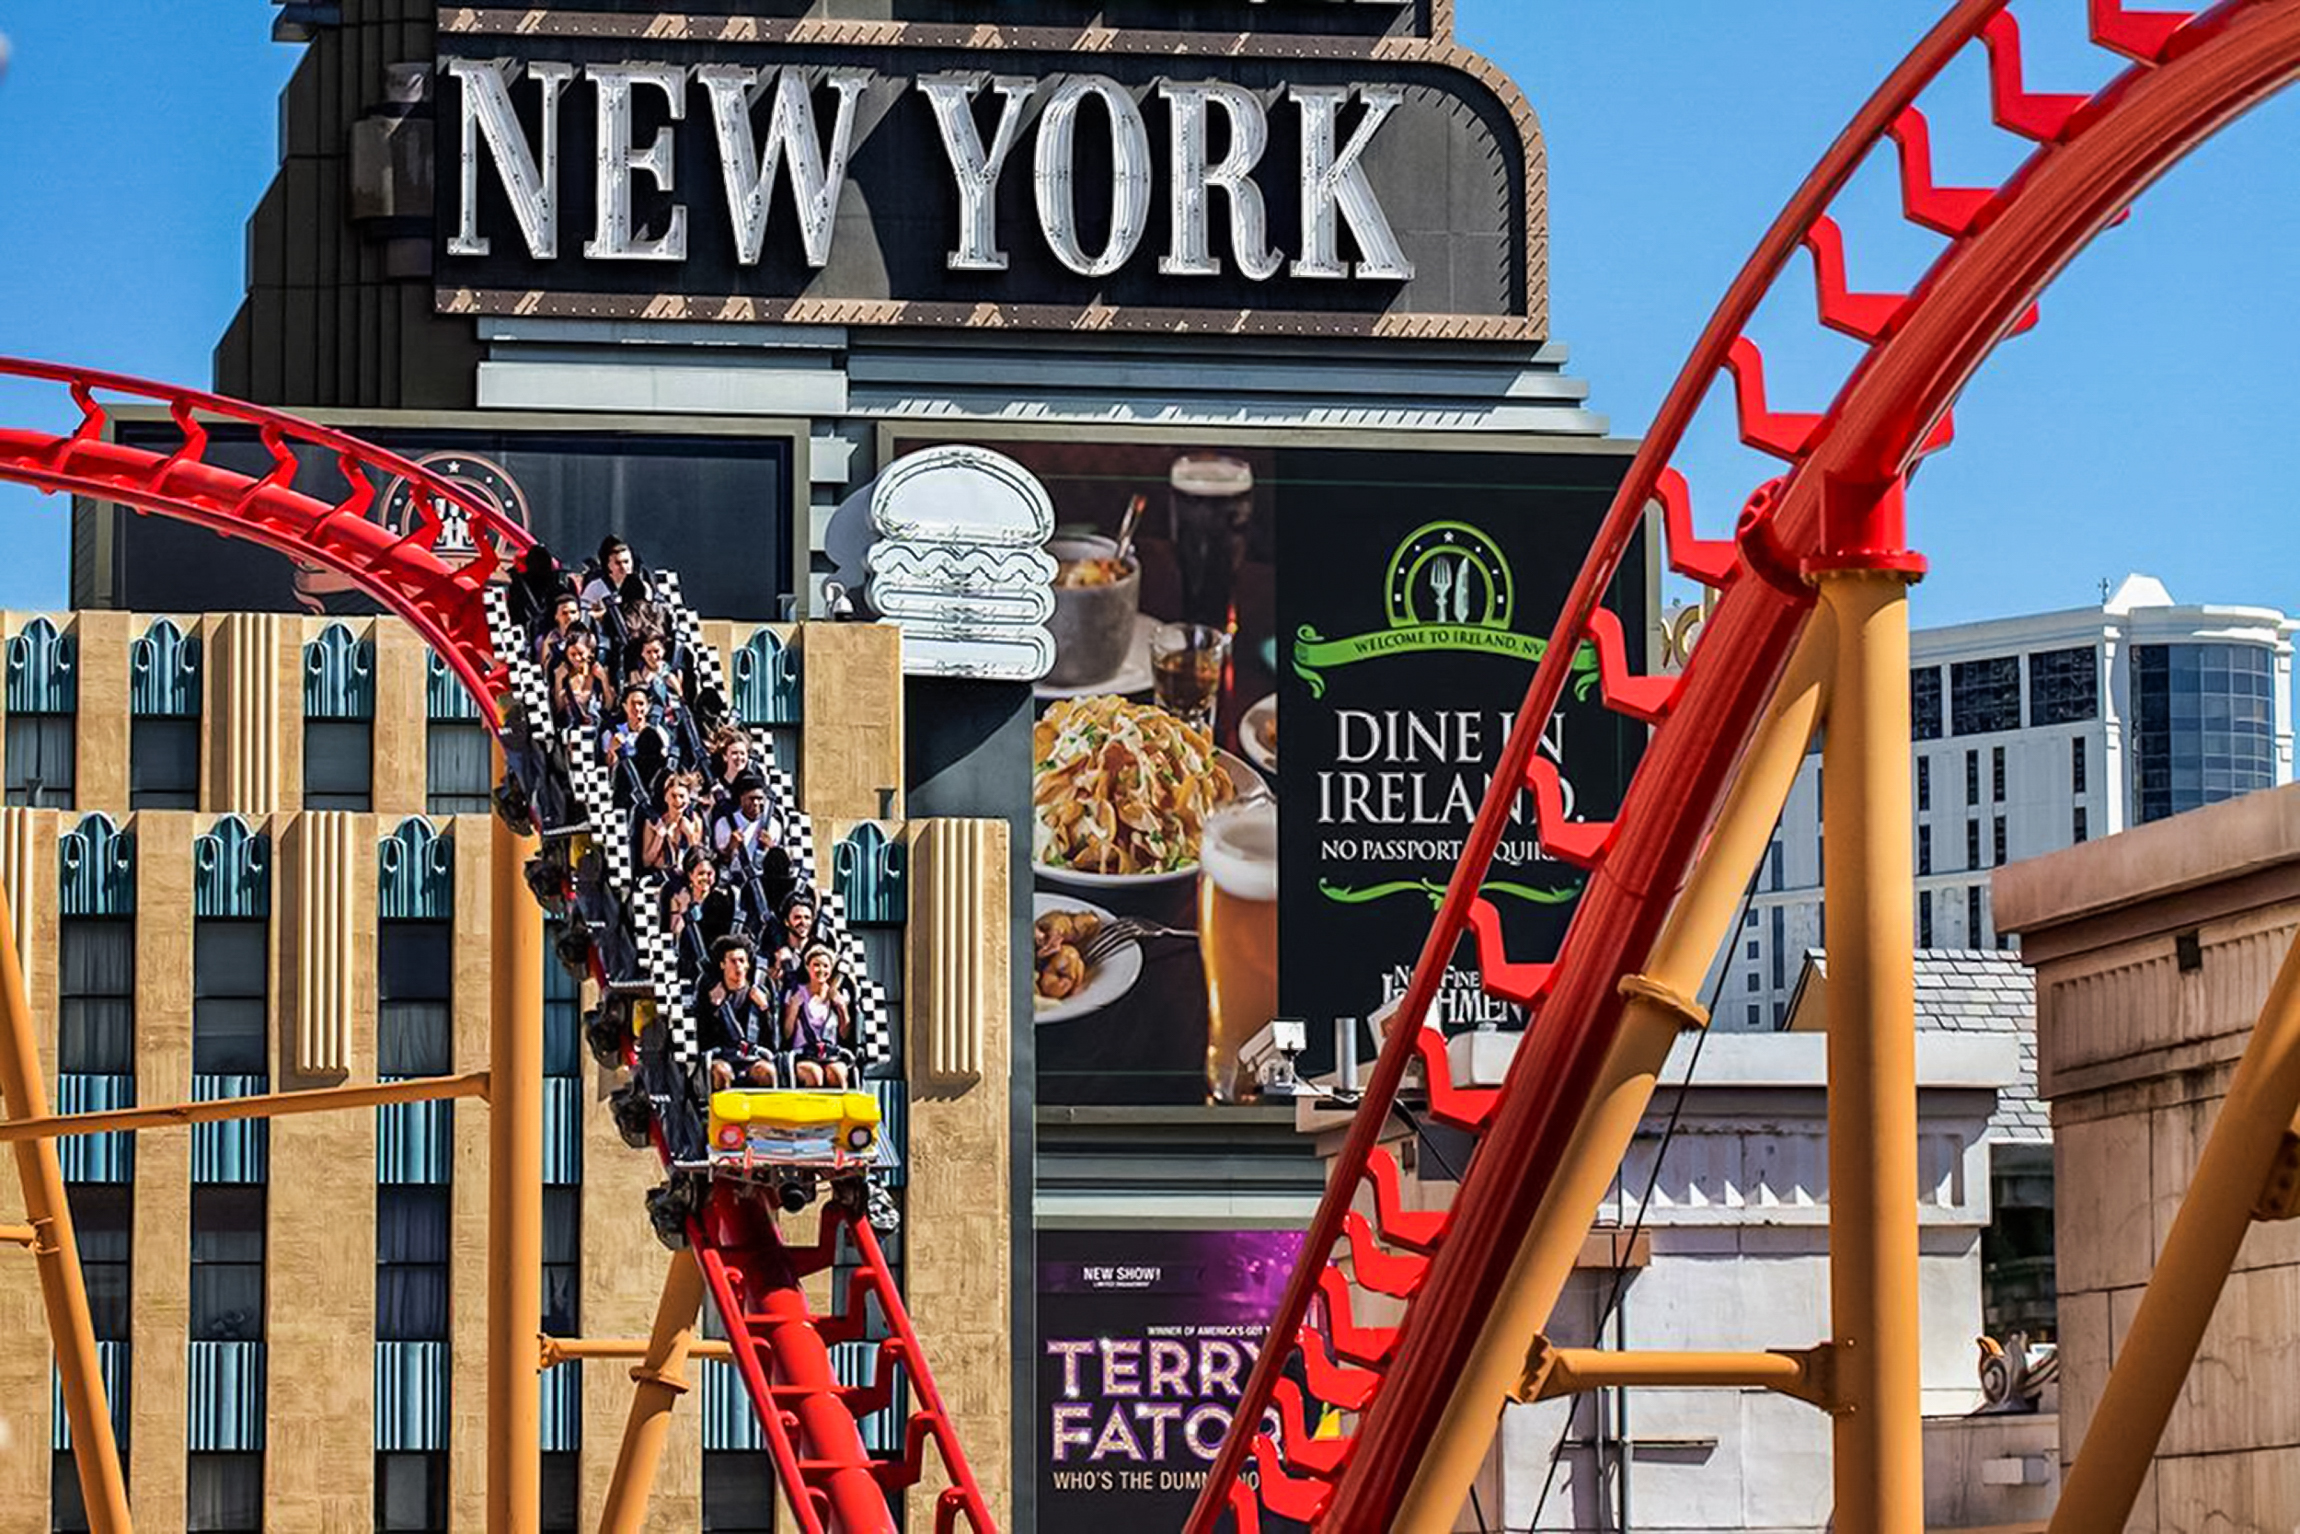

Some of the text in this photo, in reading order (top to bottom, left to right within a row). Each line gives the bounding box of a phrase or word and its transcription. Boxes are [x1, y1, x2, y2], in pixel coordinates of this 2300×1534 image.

[447, 60, 1415, 281] NEW YORK
[1354, 630, 1425, 652] WELCOME
[1430, 630, 1449, 643] TO
[1523, 641, 1544, 655] NV
[1335, 710, 1482, 763] DINE
[1321, 839, 1358, 860] NO
[1362, 839, 1463, 860] PASSPORT
[1083, 1266, 1161, 1281] NEW SHOW!
[1184, 1325, 1195, 1336] OF
[1053, 1470, 1113, 1490] WHO'S
[1119, 1470, 1153, 1490] THE
